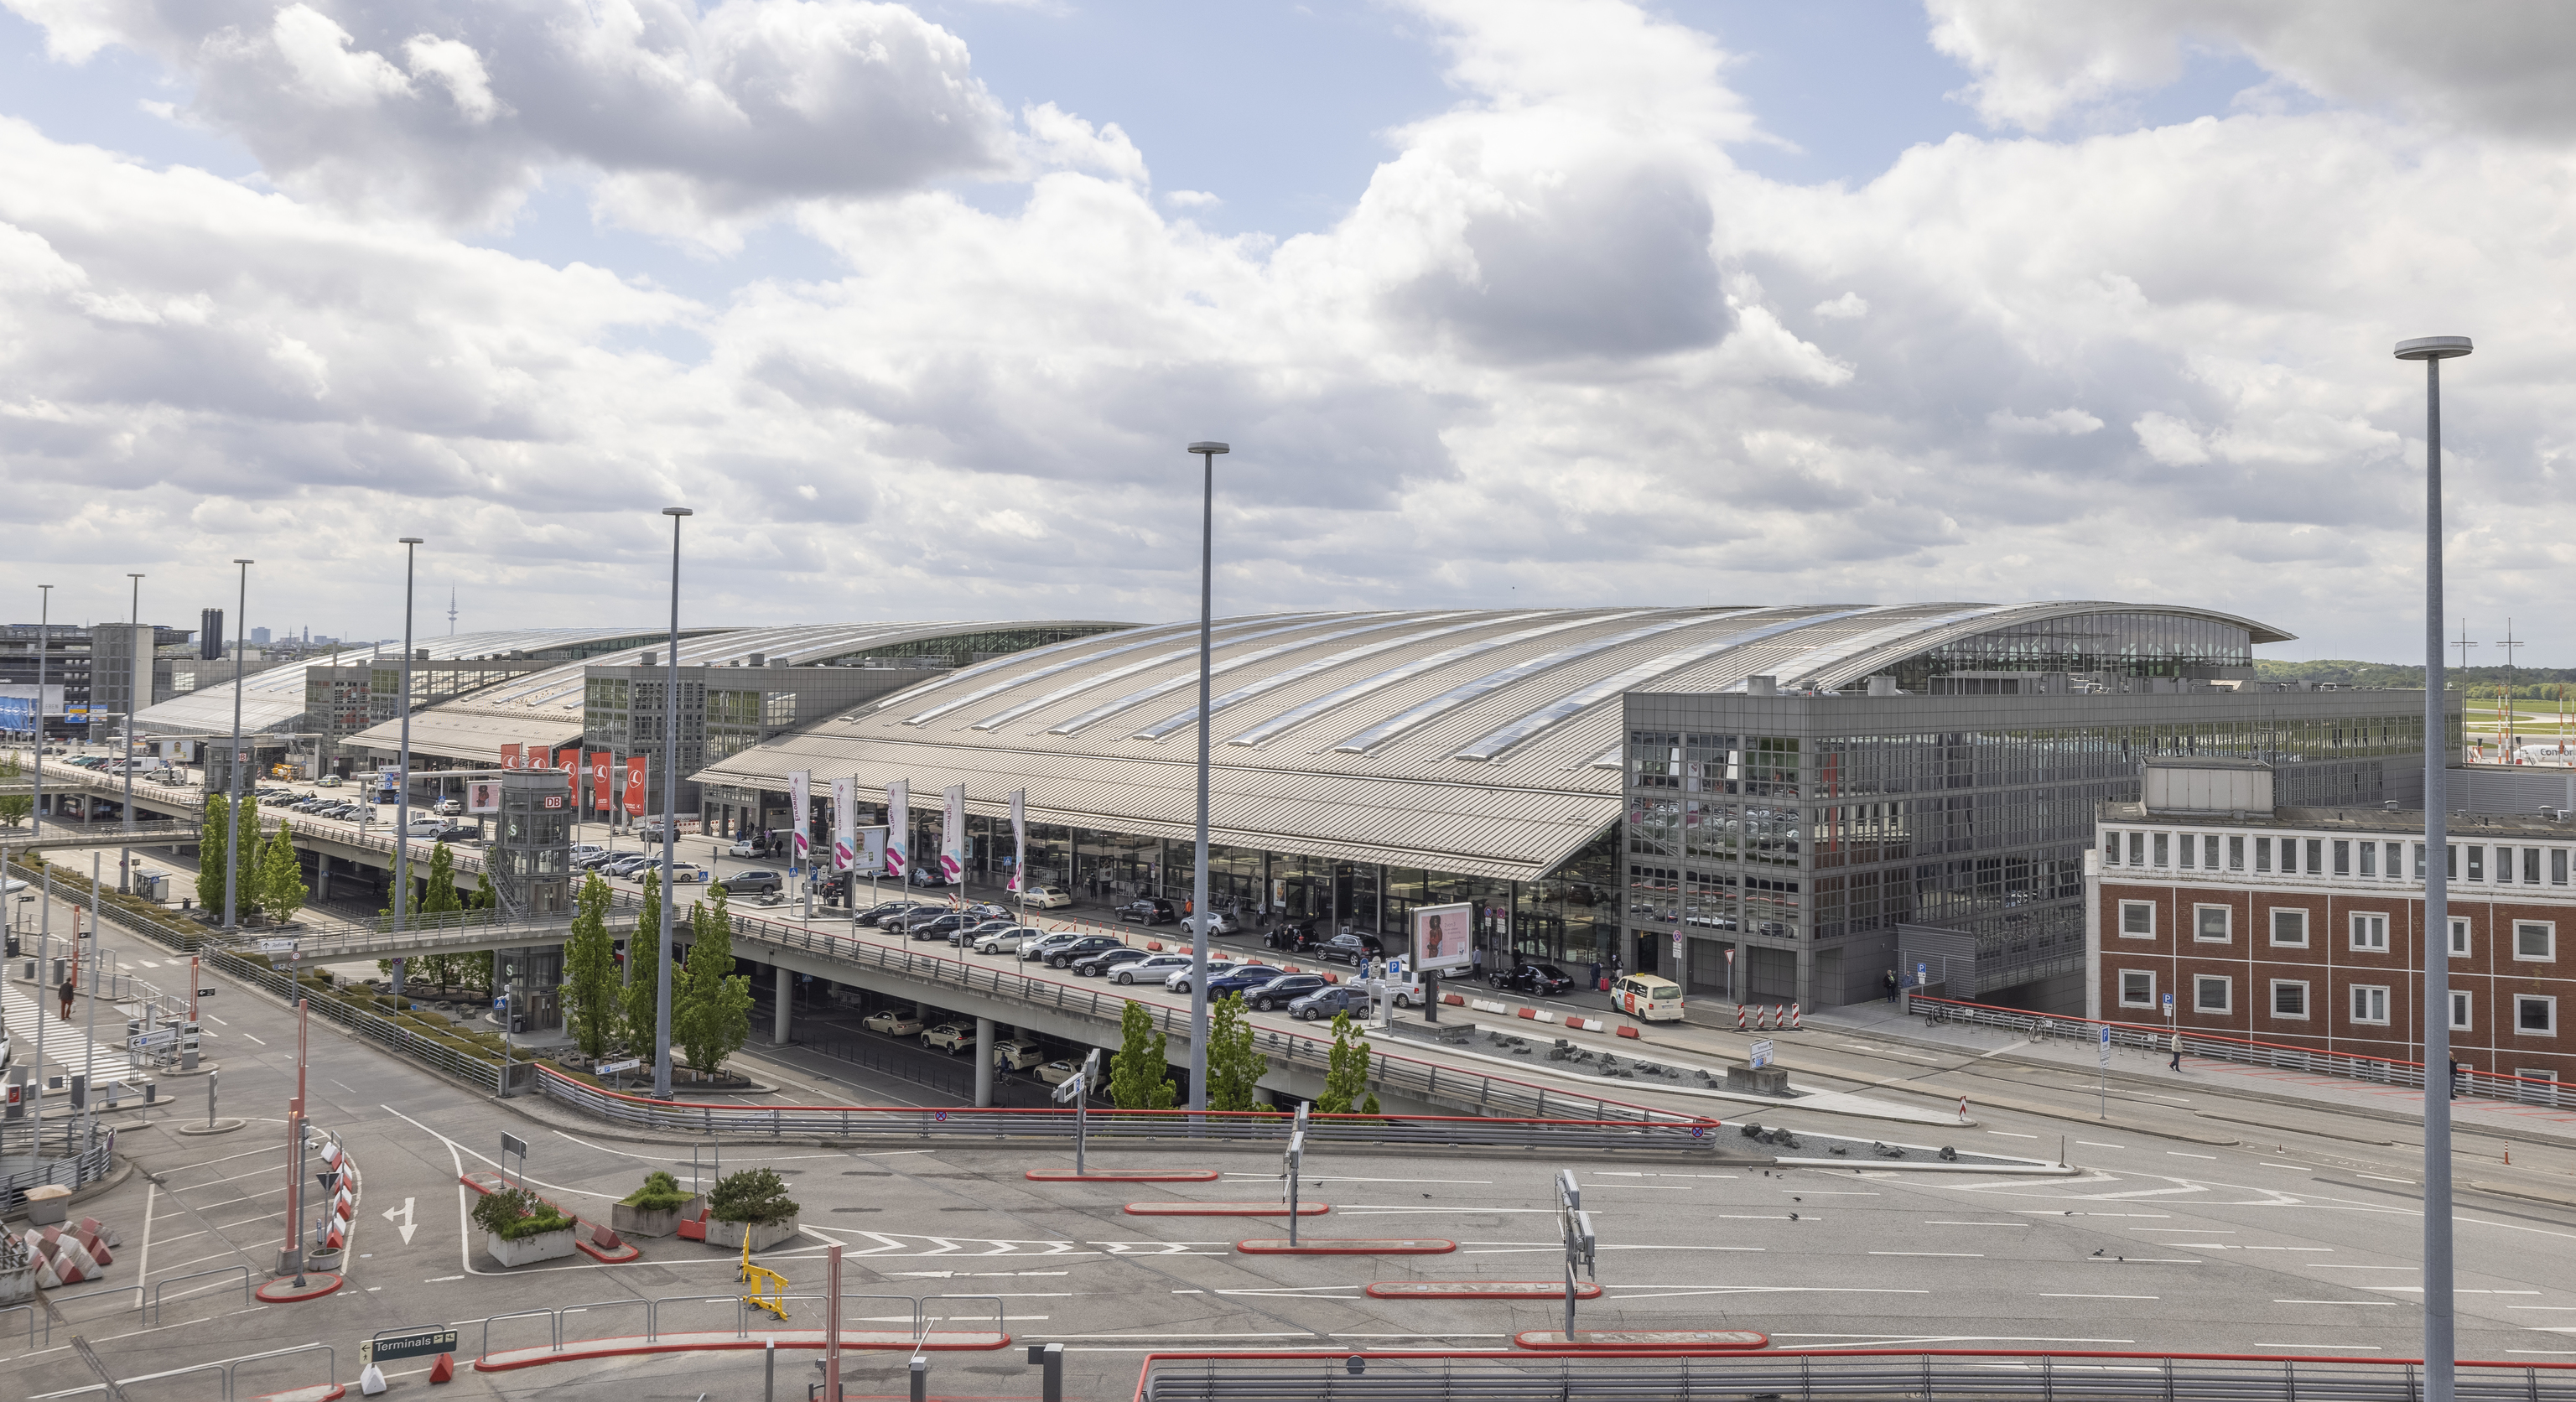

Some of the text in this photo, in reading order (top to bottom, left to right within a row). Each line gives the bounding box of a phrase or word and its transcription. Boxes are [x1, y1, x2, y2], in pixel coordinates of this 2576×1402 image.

[2540, 748, 2573, 756] Conor
[547, 797, 560, 807] DB
[510, 824, 517, 836] S
[506, 964, 512, 976] S
[1361, 963, 1368, 974] P
[1392, 963, 1398, 972] P
[2103, 1030, 2107, 1041] P
[375, 1337, 431, 1352] Terminals
